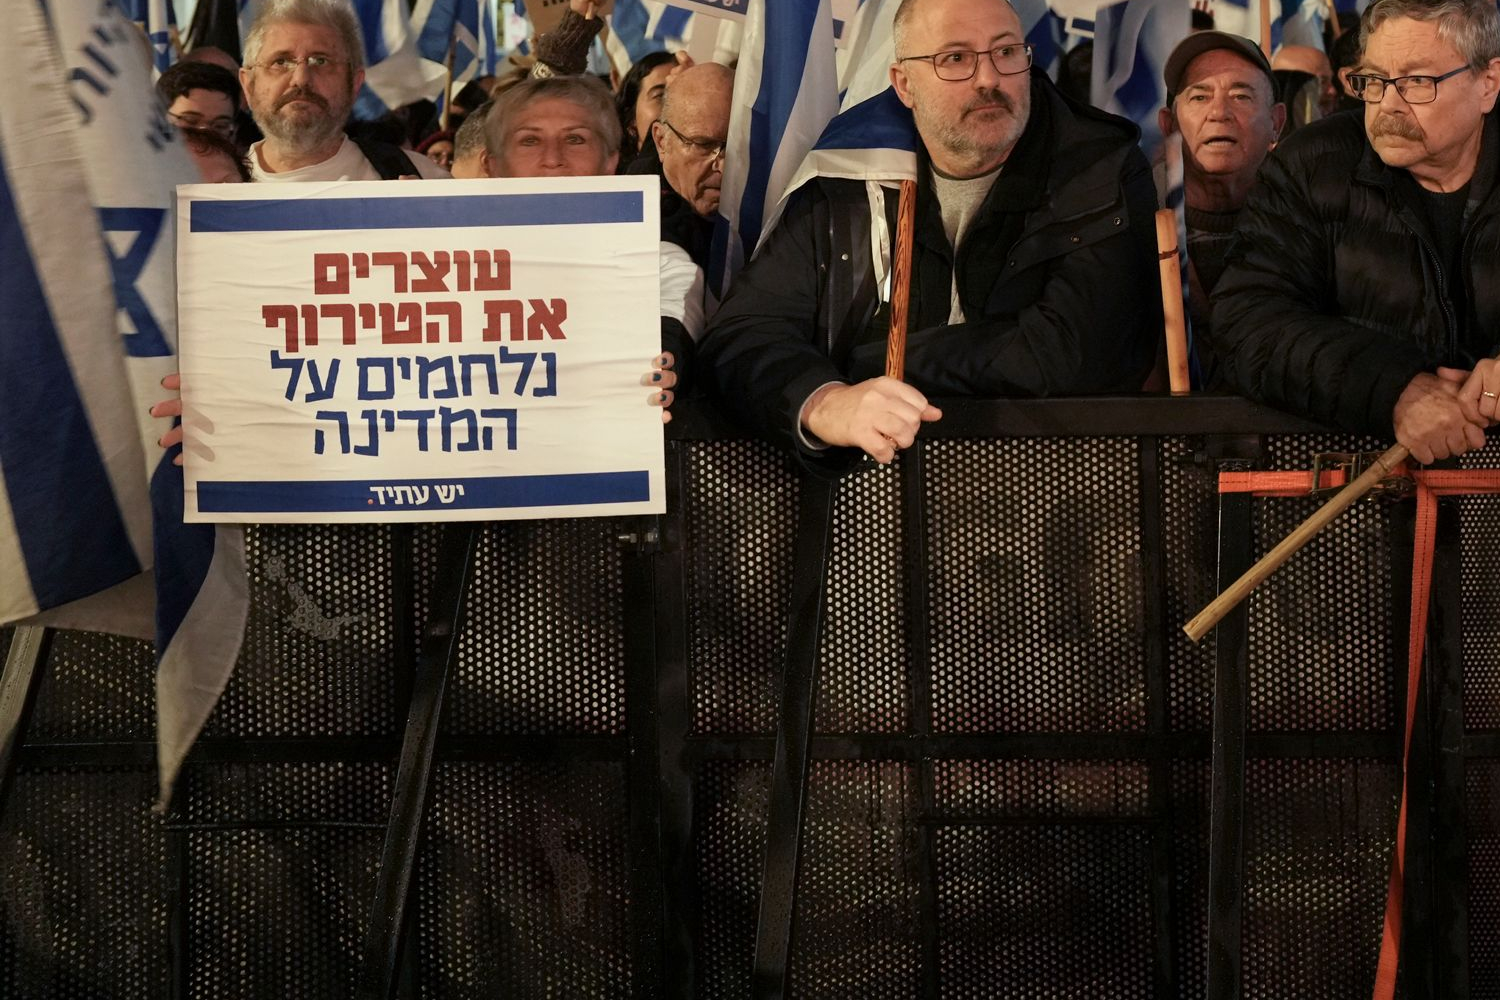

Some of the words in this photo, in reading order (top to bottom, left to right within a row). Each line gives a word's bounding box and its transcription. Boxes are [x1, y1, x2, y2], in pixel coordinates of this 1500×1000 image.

[313, 249, 512, 296] עוצרים
[261, 301, 463, 353] הטירוף
[482, 298, 568, 342] את
[271, 350, 341, 403] על
[357, 345, 557, 400] נלחמים
[314, 406, 519, 457] המדינה
[434, 483, 465, 503] יש
